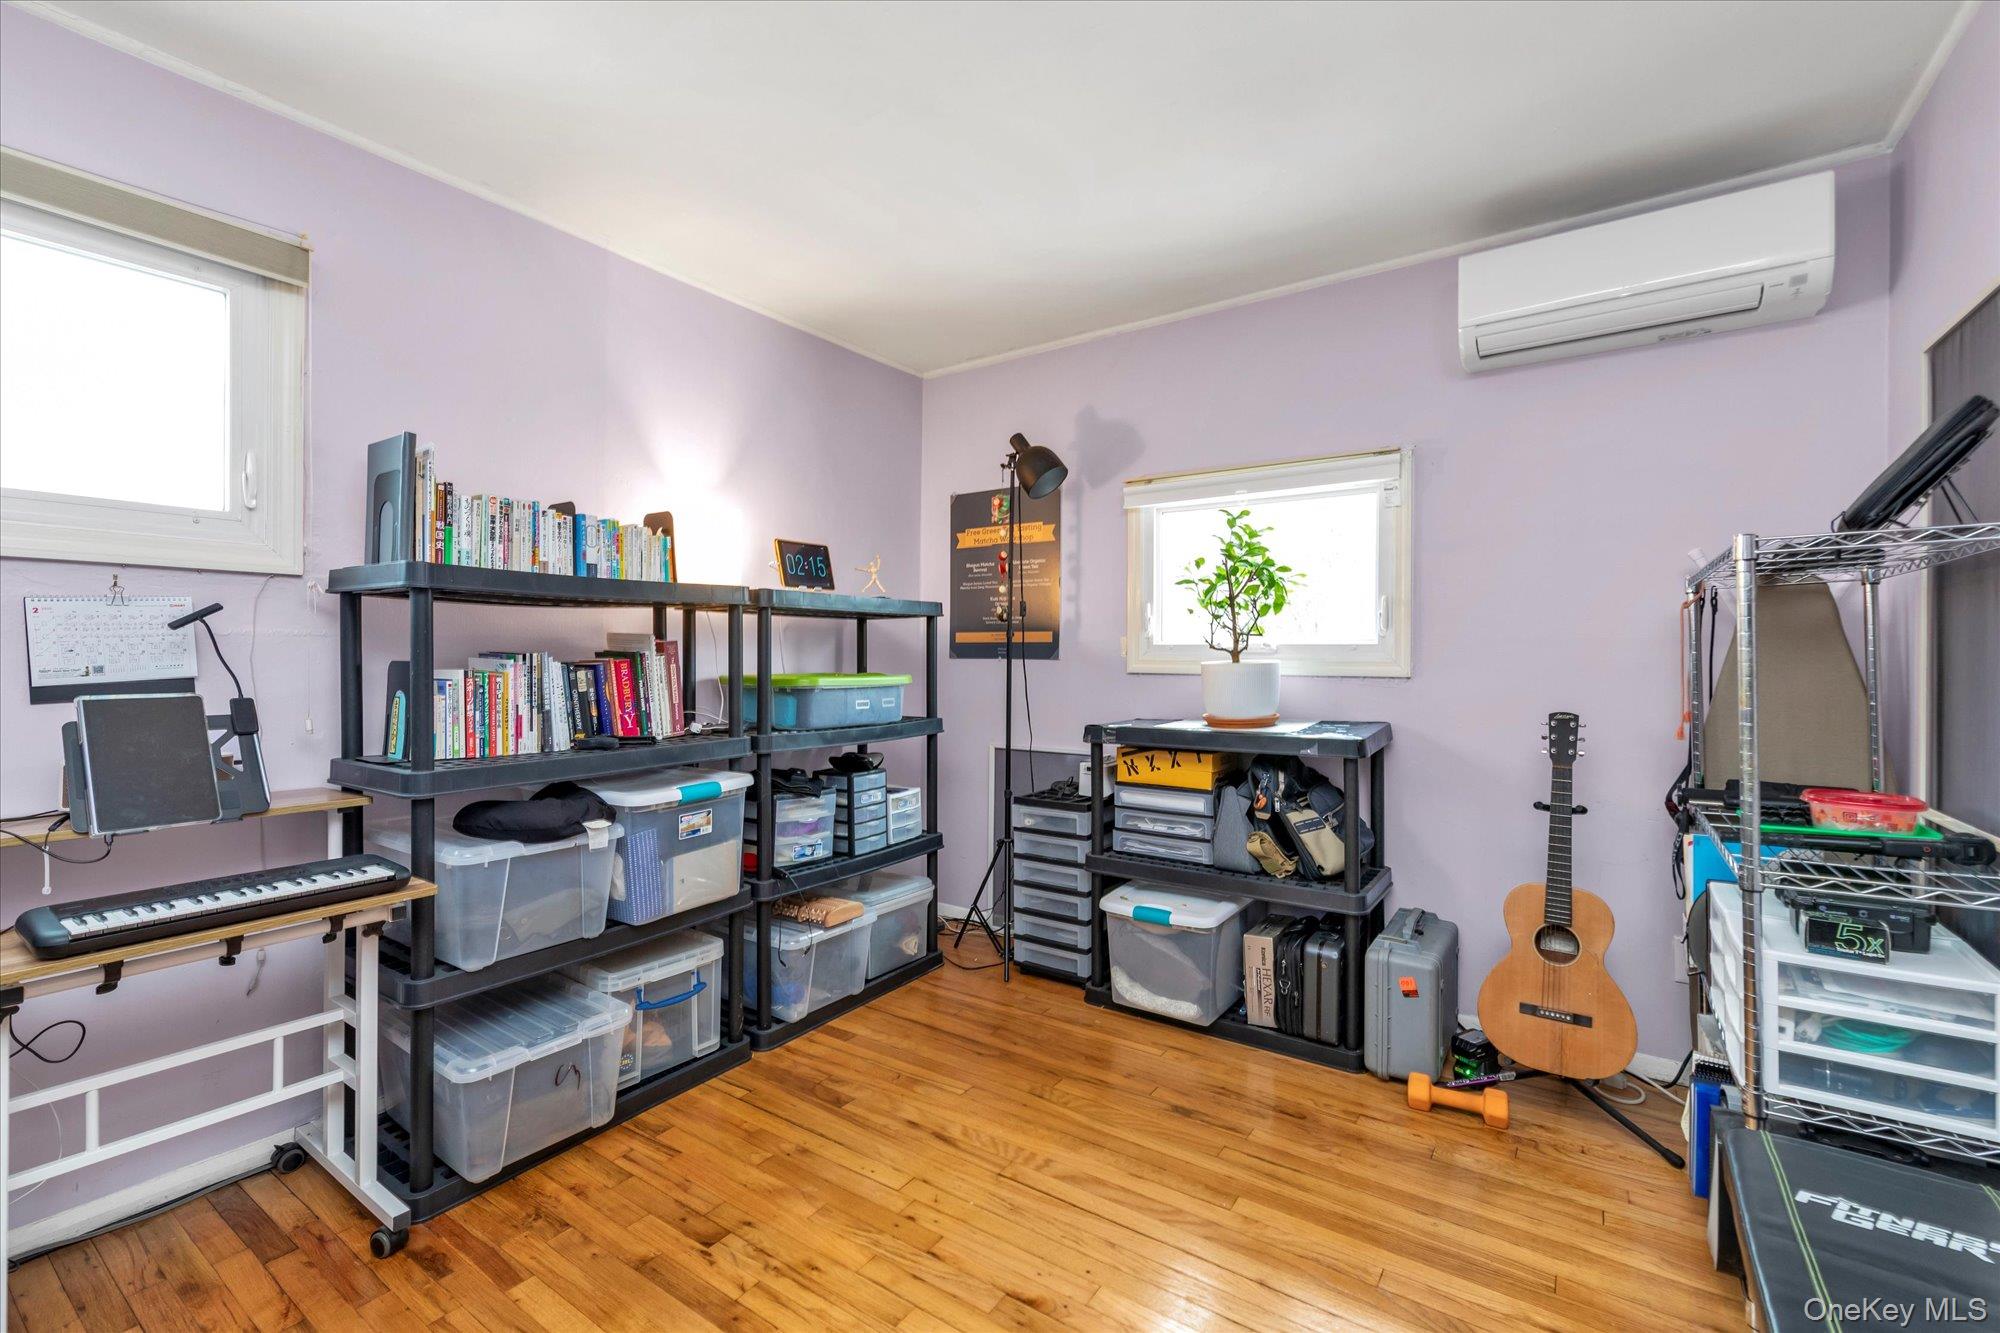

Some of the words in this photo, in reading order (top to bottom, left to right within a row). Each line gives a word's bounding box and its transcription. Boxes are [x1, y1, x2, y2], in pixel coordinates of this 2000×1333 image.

[966, 528, 981, 537] Free
[973, 537, 998, 545] Matcha
[999, 534, 1034, 544] Wokhop
[785, 553, 827, 578] 02:15
[620, 663, 634, 713] BRADBURY
[571, 689, 583, 730] ORNITHERAPY
[1834, 922, 1885, 955] 5x
[1262, 968, 1273, 1005] HEXAR
[1264, 1005, 1271, 1016] RF
[1830, 1207, 1996, 1265] GEAR
